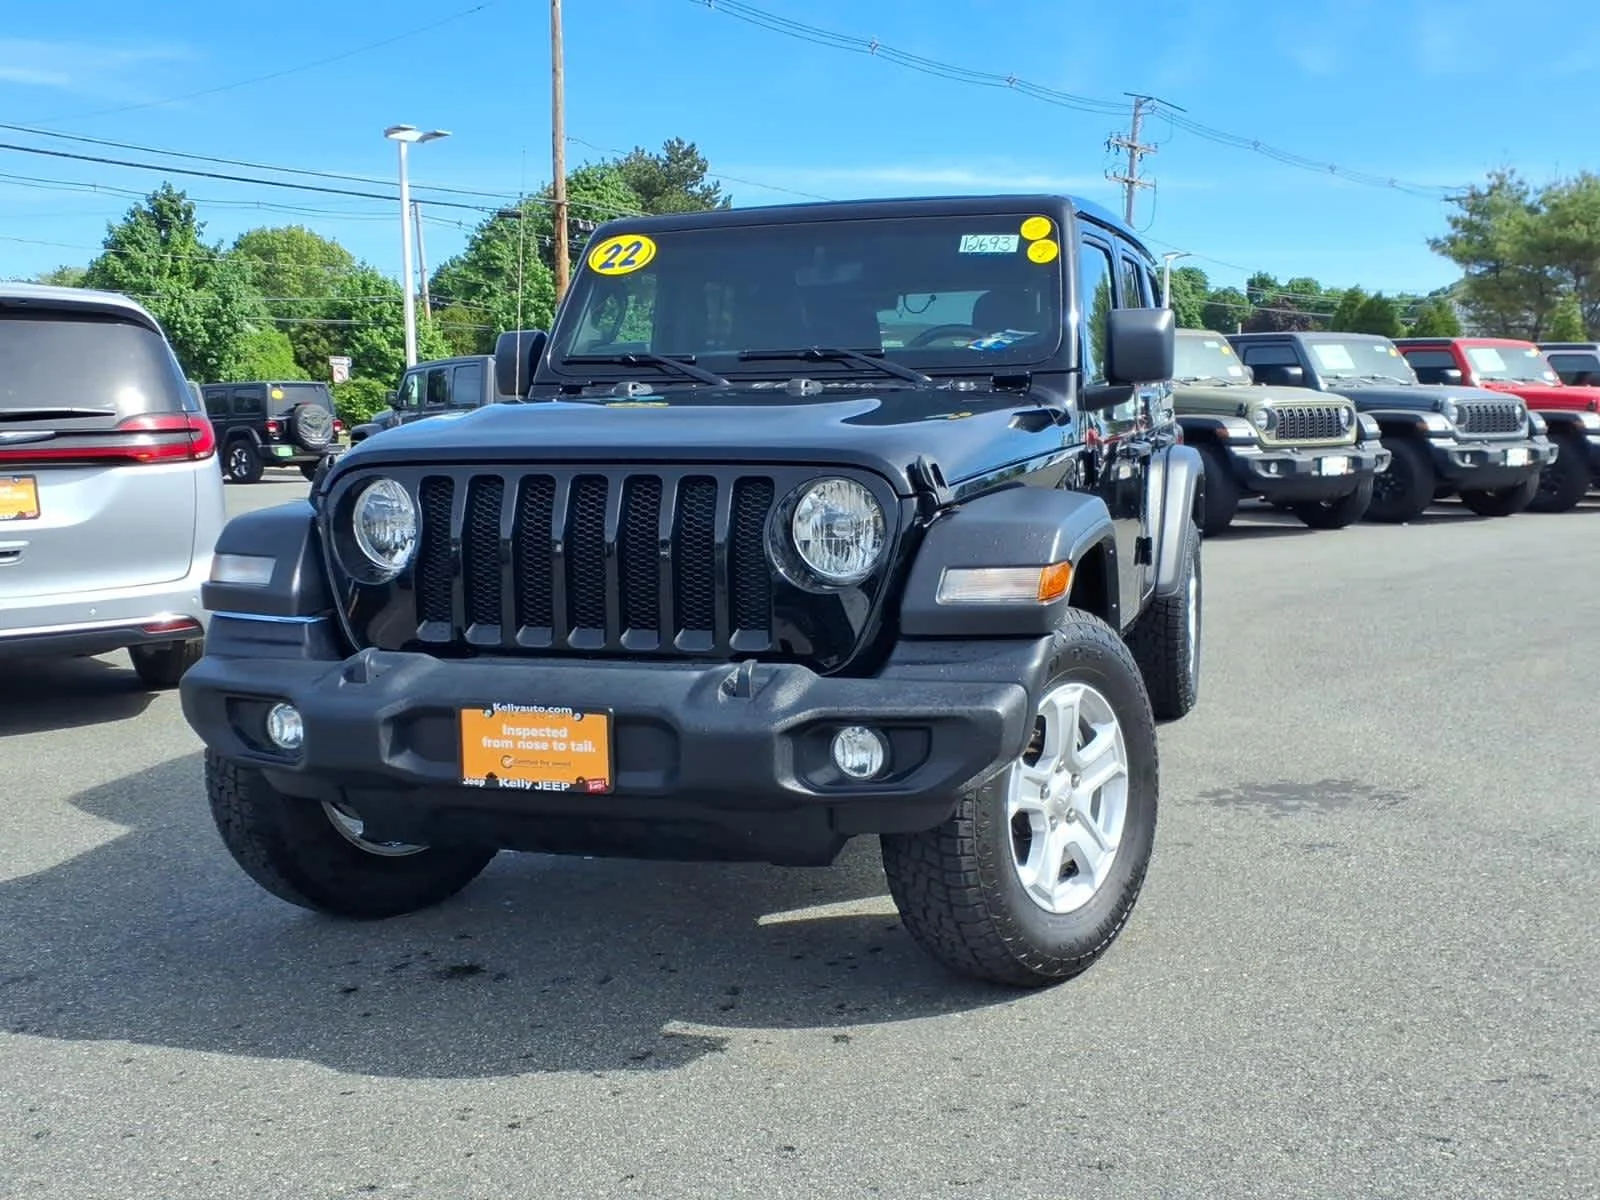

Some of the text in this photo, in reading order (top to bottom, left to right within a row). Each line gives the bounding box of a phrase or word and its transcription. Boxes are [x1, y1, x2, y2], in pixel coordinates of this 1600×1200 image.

[963, 235, 1010, 252] 12693
[599, 240, 643, 270] 22
[492, 702, 573, 715] Kellyauto.com
[502, 723, 568, 739] Inspected
[482, 736, 596, 753] from nose to tail.
[463, 777, 486, 787] Jeep
[499, 778, 571, 792] Kelly JEEP
